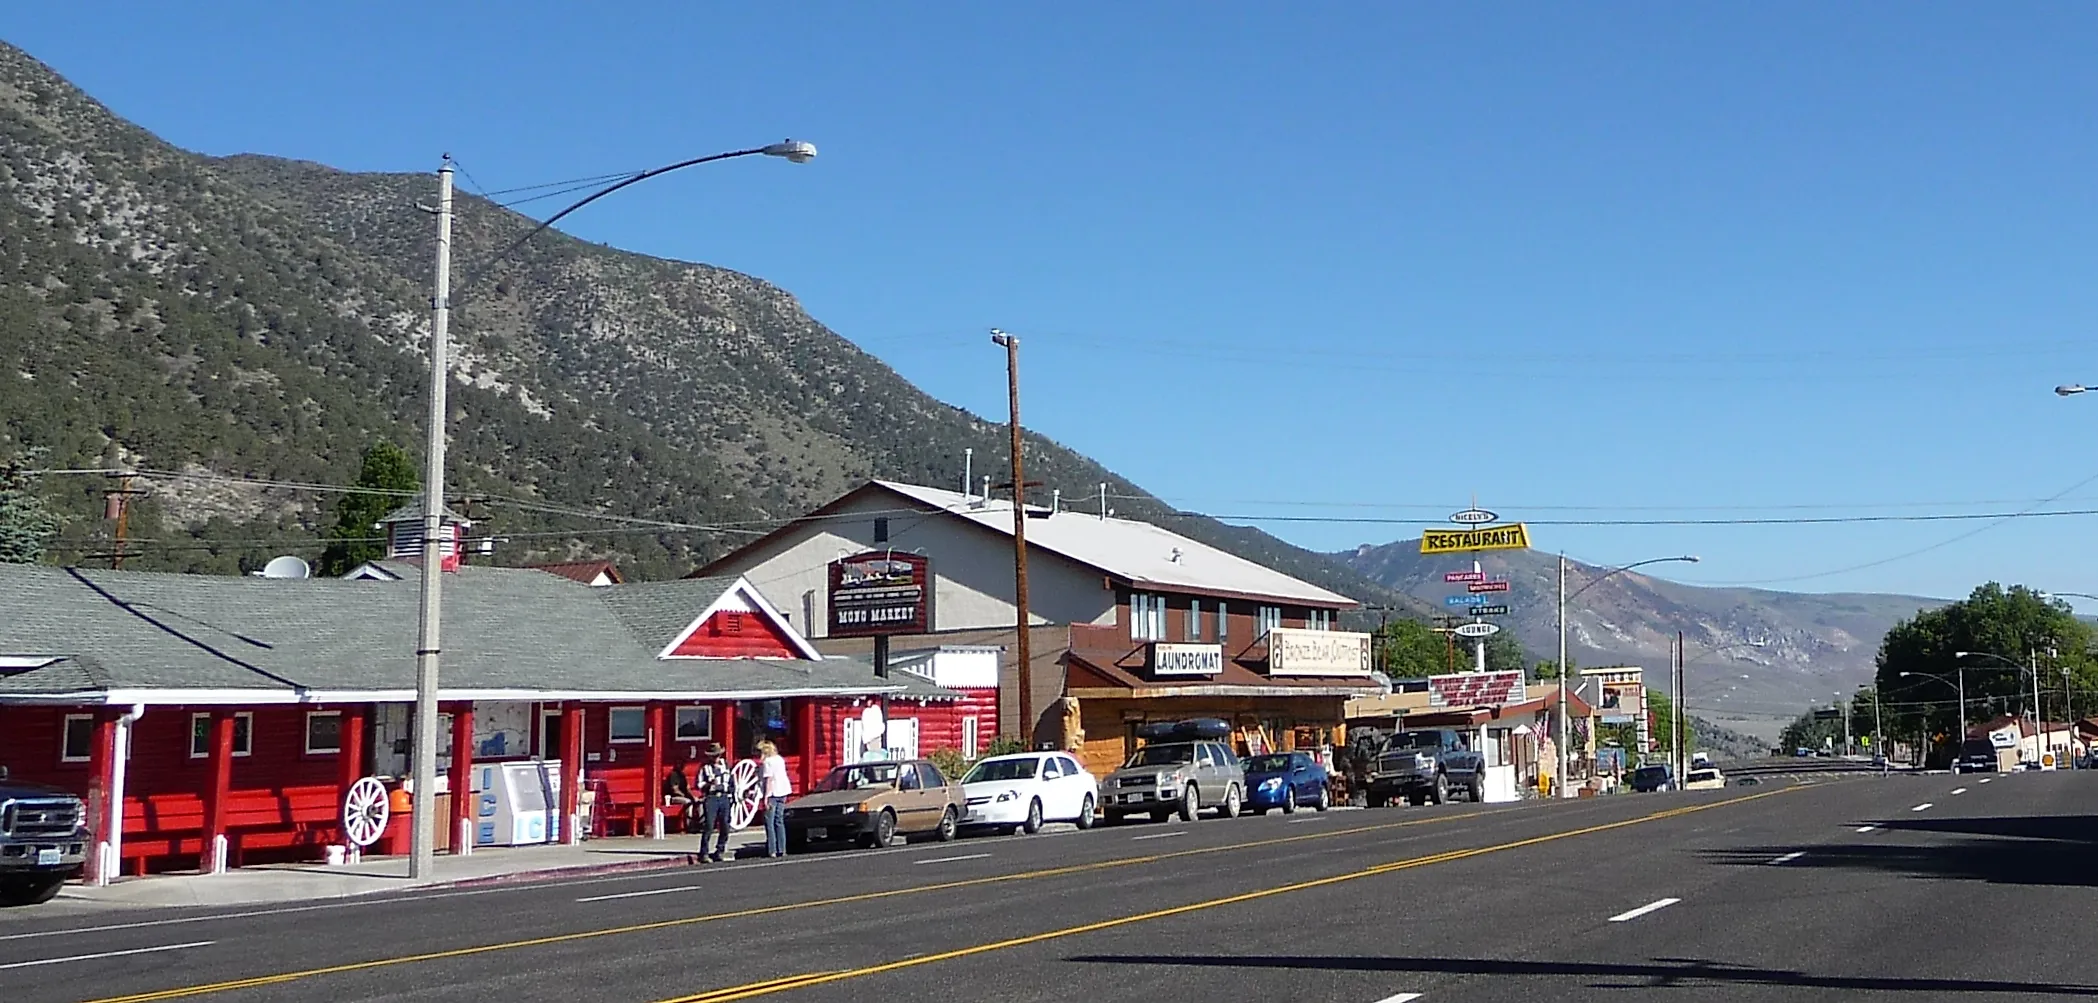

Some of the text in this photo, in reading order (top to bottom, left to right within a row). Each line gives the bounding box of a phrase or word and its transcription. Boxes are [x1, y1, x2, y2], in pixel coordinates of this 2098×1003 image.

[1426, 530, 1519, 549] RESTAURANT
[838, 606, 915, 624] MONO MARKET
[1461, 625, 1492, 634] LOUNGE
[1156, 651, 1220, 671] LAUNDROMAT
[478, 768, 496, 844] ICE
